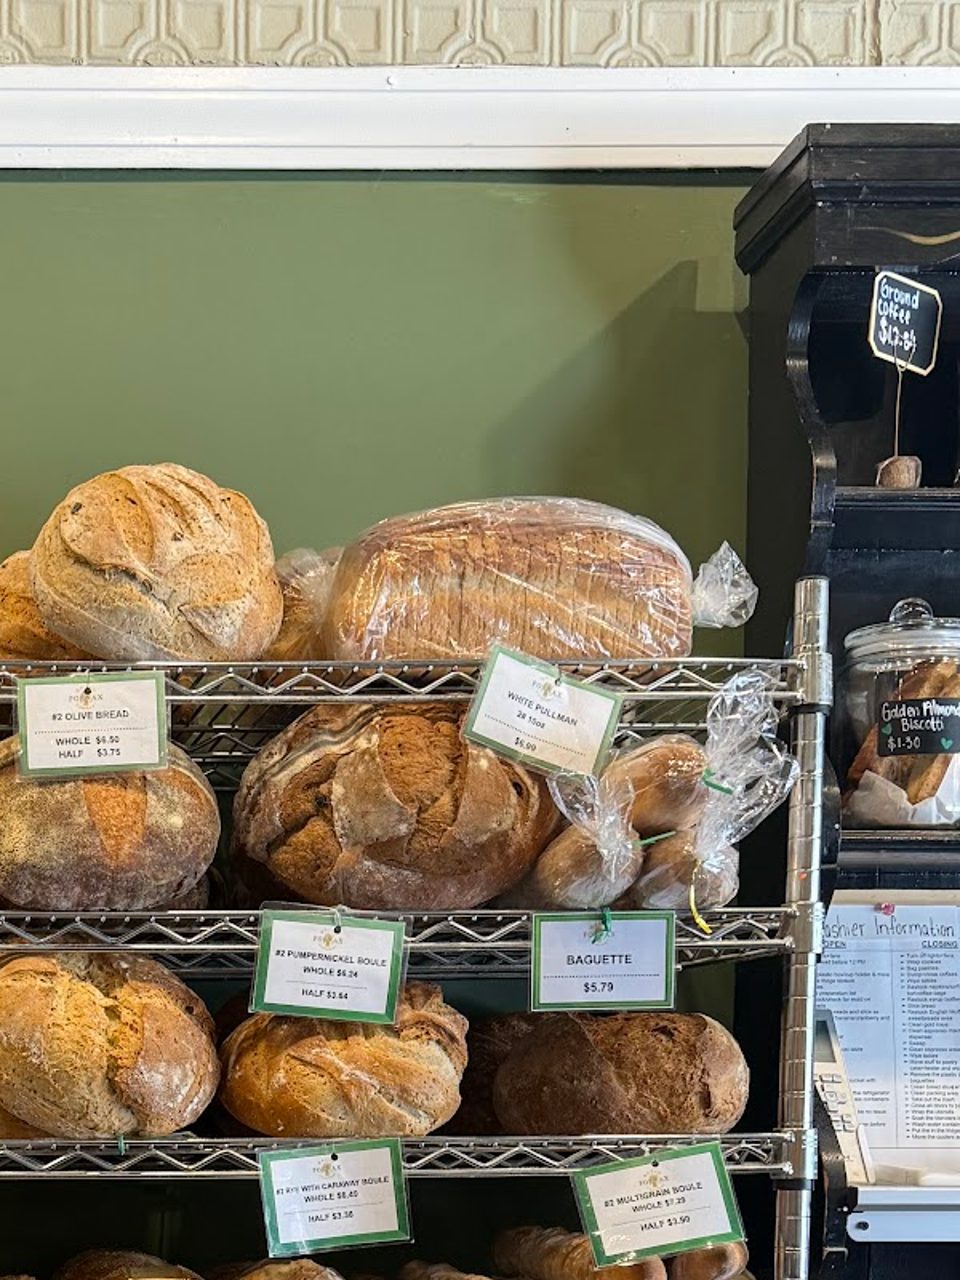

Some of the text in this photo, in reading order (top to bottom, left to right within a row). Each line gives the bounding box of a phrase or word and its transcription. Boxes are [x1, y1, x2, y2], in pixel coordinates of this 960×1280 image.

[881, 278, 920, 309] Ground
[508, 690, 578, 726] WHITE PULLMAN
[882, 702, 920, 722] Golden
[65, 711, 93, 720] OLIVE
[96, 710, 129, 719] BREAD
[901, 716, 944, 732] Biscotti
[56, 736, 90, 746] WHOLE
[58, 750, 84, 758] HALF
[822, 915, 955, 938] ashier Information
[921, 940, 958, 949] CLOSING
[287, 950, 355, 964] PUMPERNICKEL
[357, 956, 388, 967] BOULE
[566, 954, 632, 965] BAGUETTE
[303, 966, 334, 976] WHOLE
[302, 988, 326, 998] HALF
[584, 982, 614, 993] $5.79
[321, 1180, 360, 1190] CARAWAY
[361, 1176, 390, 1186] BOULE
[304, 1192, 335, 1203] WHOLE
[616, 1188, 671, 1206] MULTIGRAIN
[672, 1182, 703, 1194] BOULE
[631, 1202, 663, 1213] WHOLE
[308, 1213, 330, 1222] HALF
[640, 1220, 664, 1232] HALF
